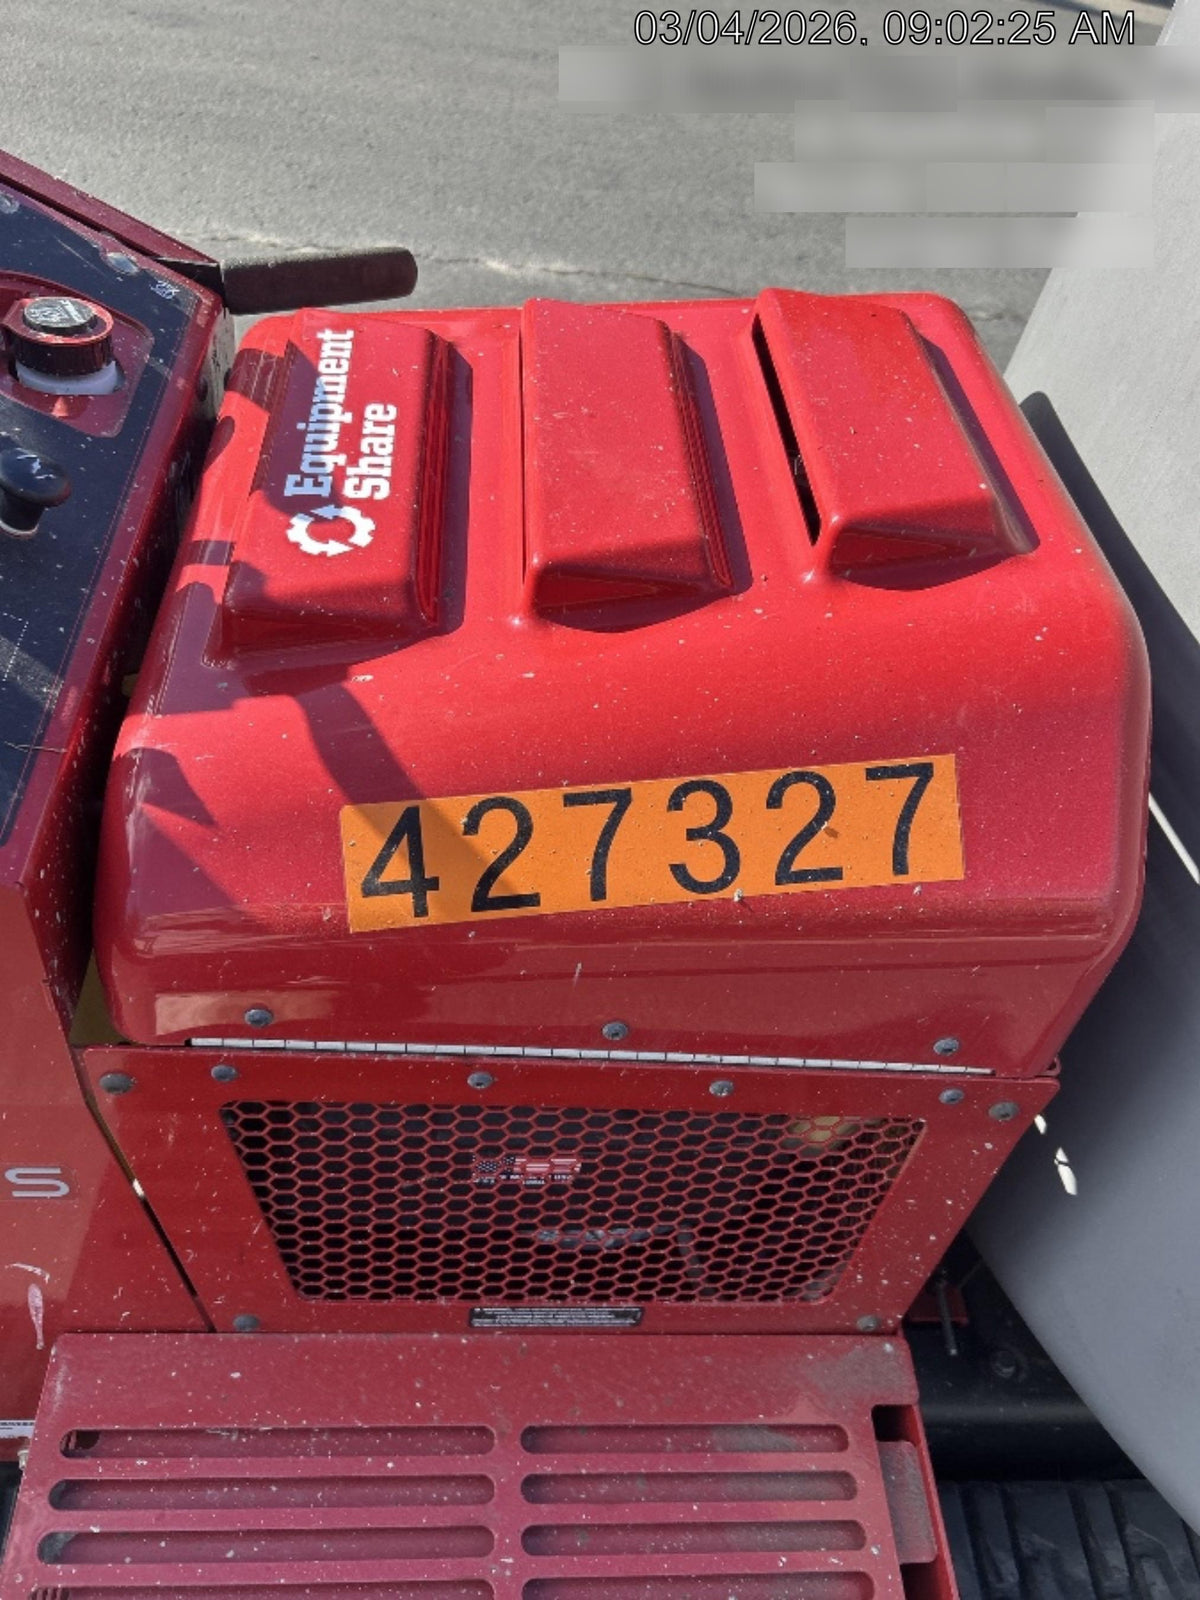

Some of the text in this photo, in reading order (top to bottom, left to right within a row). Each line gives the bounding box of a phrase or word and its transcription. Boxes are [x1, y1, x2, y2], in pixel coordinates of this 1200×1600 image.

[284, 328, 355, 499] Equipment
[342, 402, 397, 500] Share
[360, 761, 935, 918] 427327
